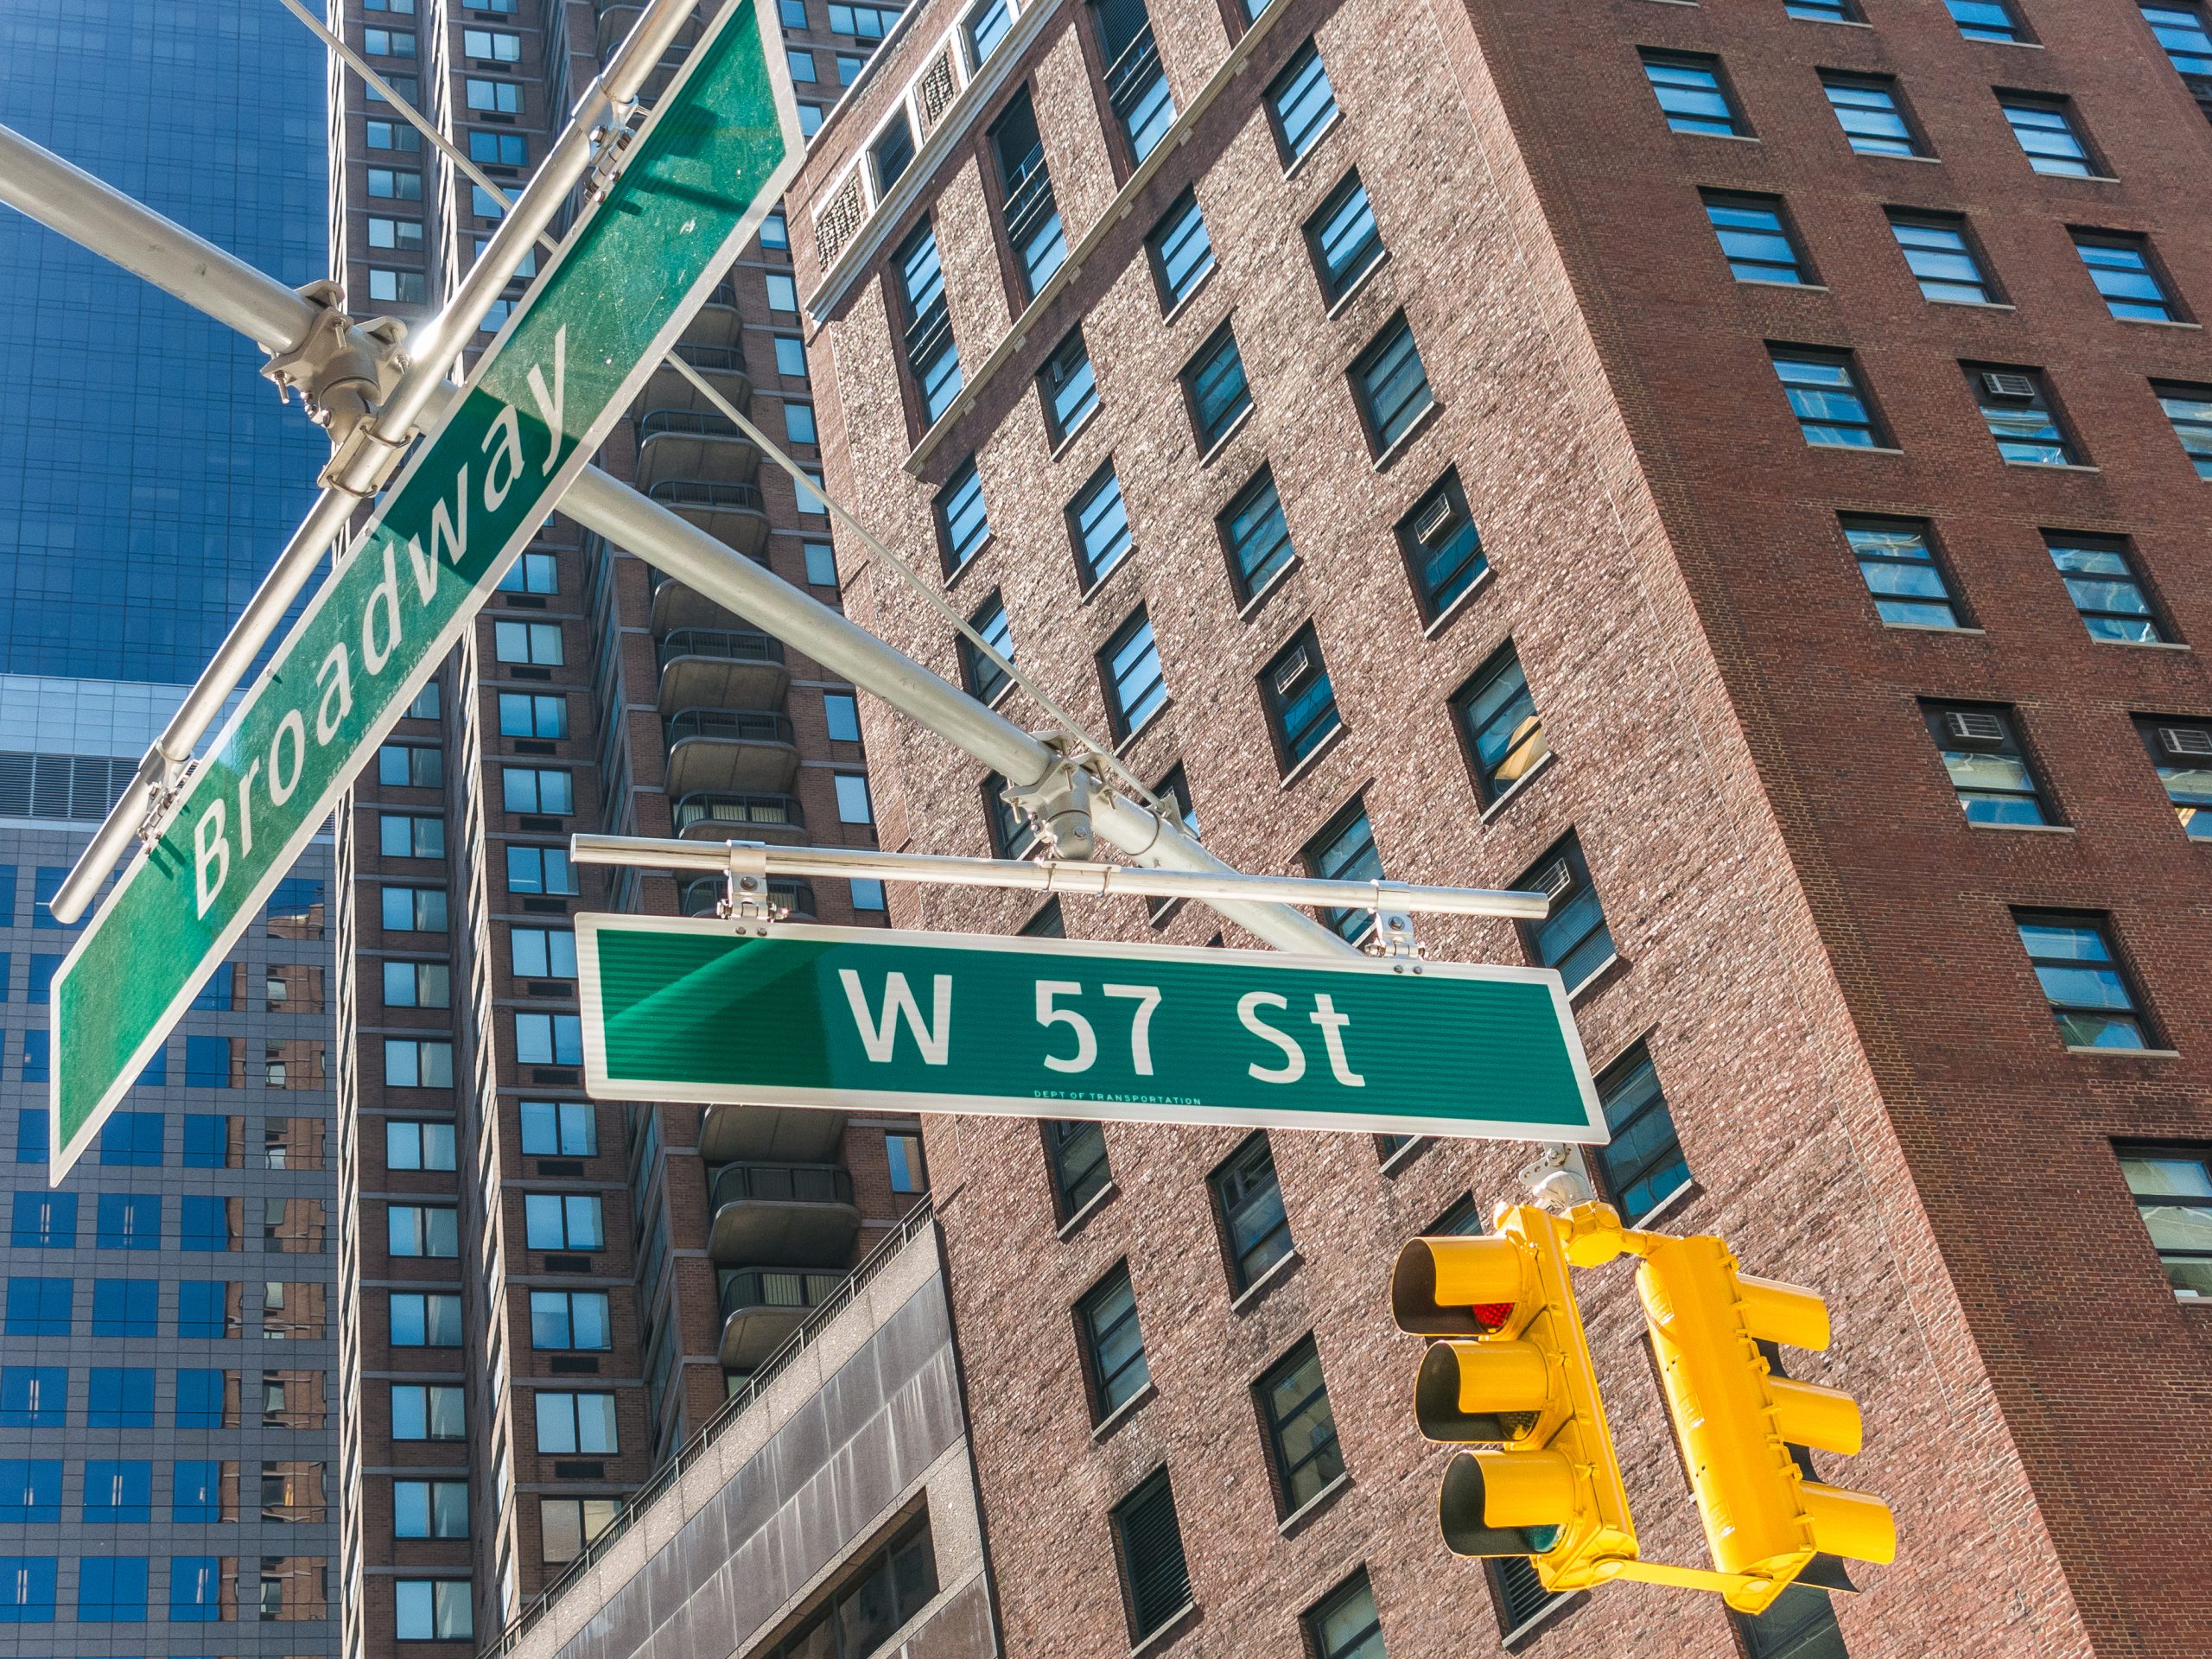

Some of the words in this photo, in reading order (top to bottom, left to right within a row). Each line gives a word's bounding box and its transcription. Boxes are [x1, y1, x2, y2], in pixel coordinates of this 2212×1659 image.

[194, 323, 569, 922] Broadway
[327, 754, 346, 785] DEPT
[348, 739, 359, 755] OF
[360, 638, 433, 736] TRANSPORTATION
[837, 968, 953, 1065] W
[1034, 979, 1163, 1076] 57
[1236, 990, 1366, 1088] St
[1033, 1090, 1065, 1099] DEPT
[1070, 1091, 1085, 1100] OF
[1089, 1092, 1202, 1106] TRANSPORTATION
